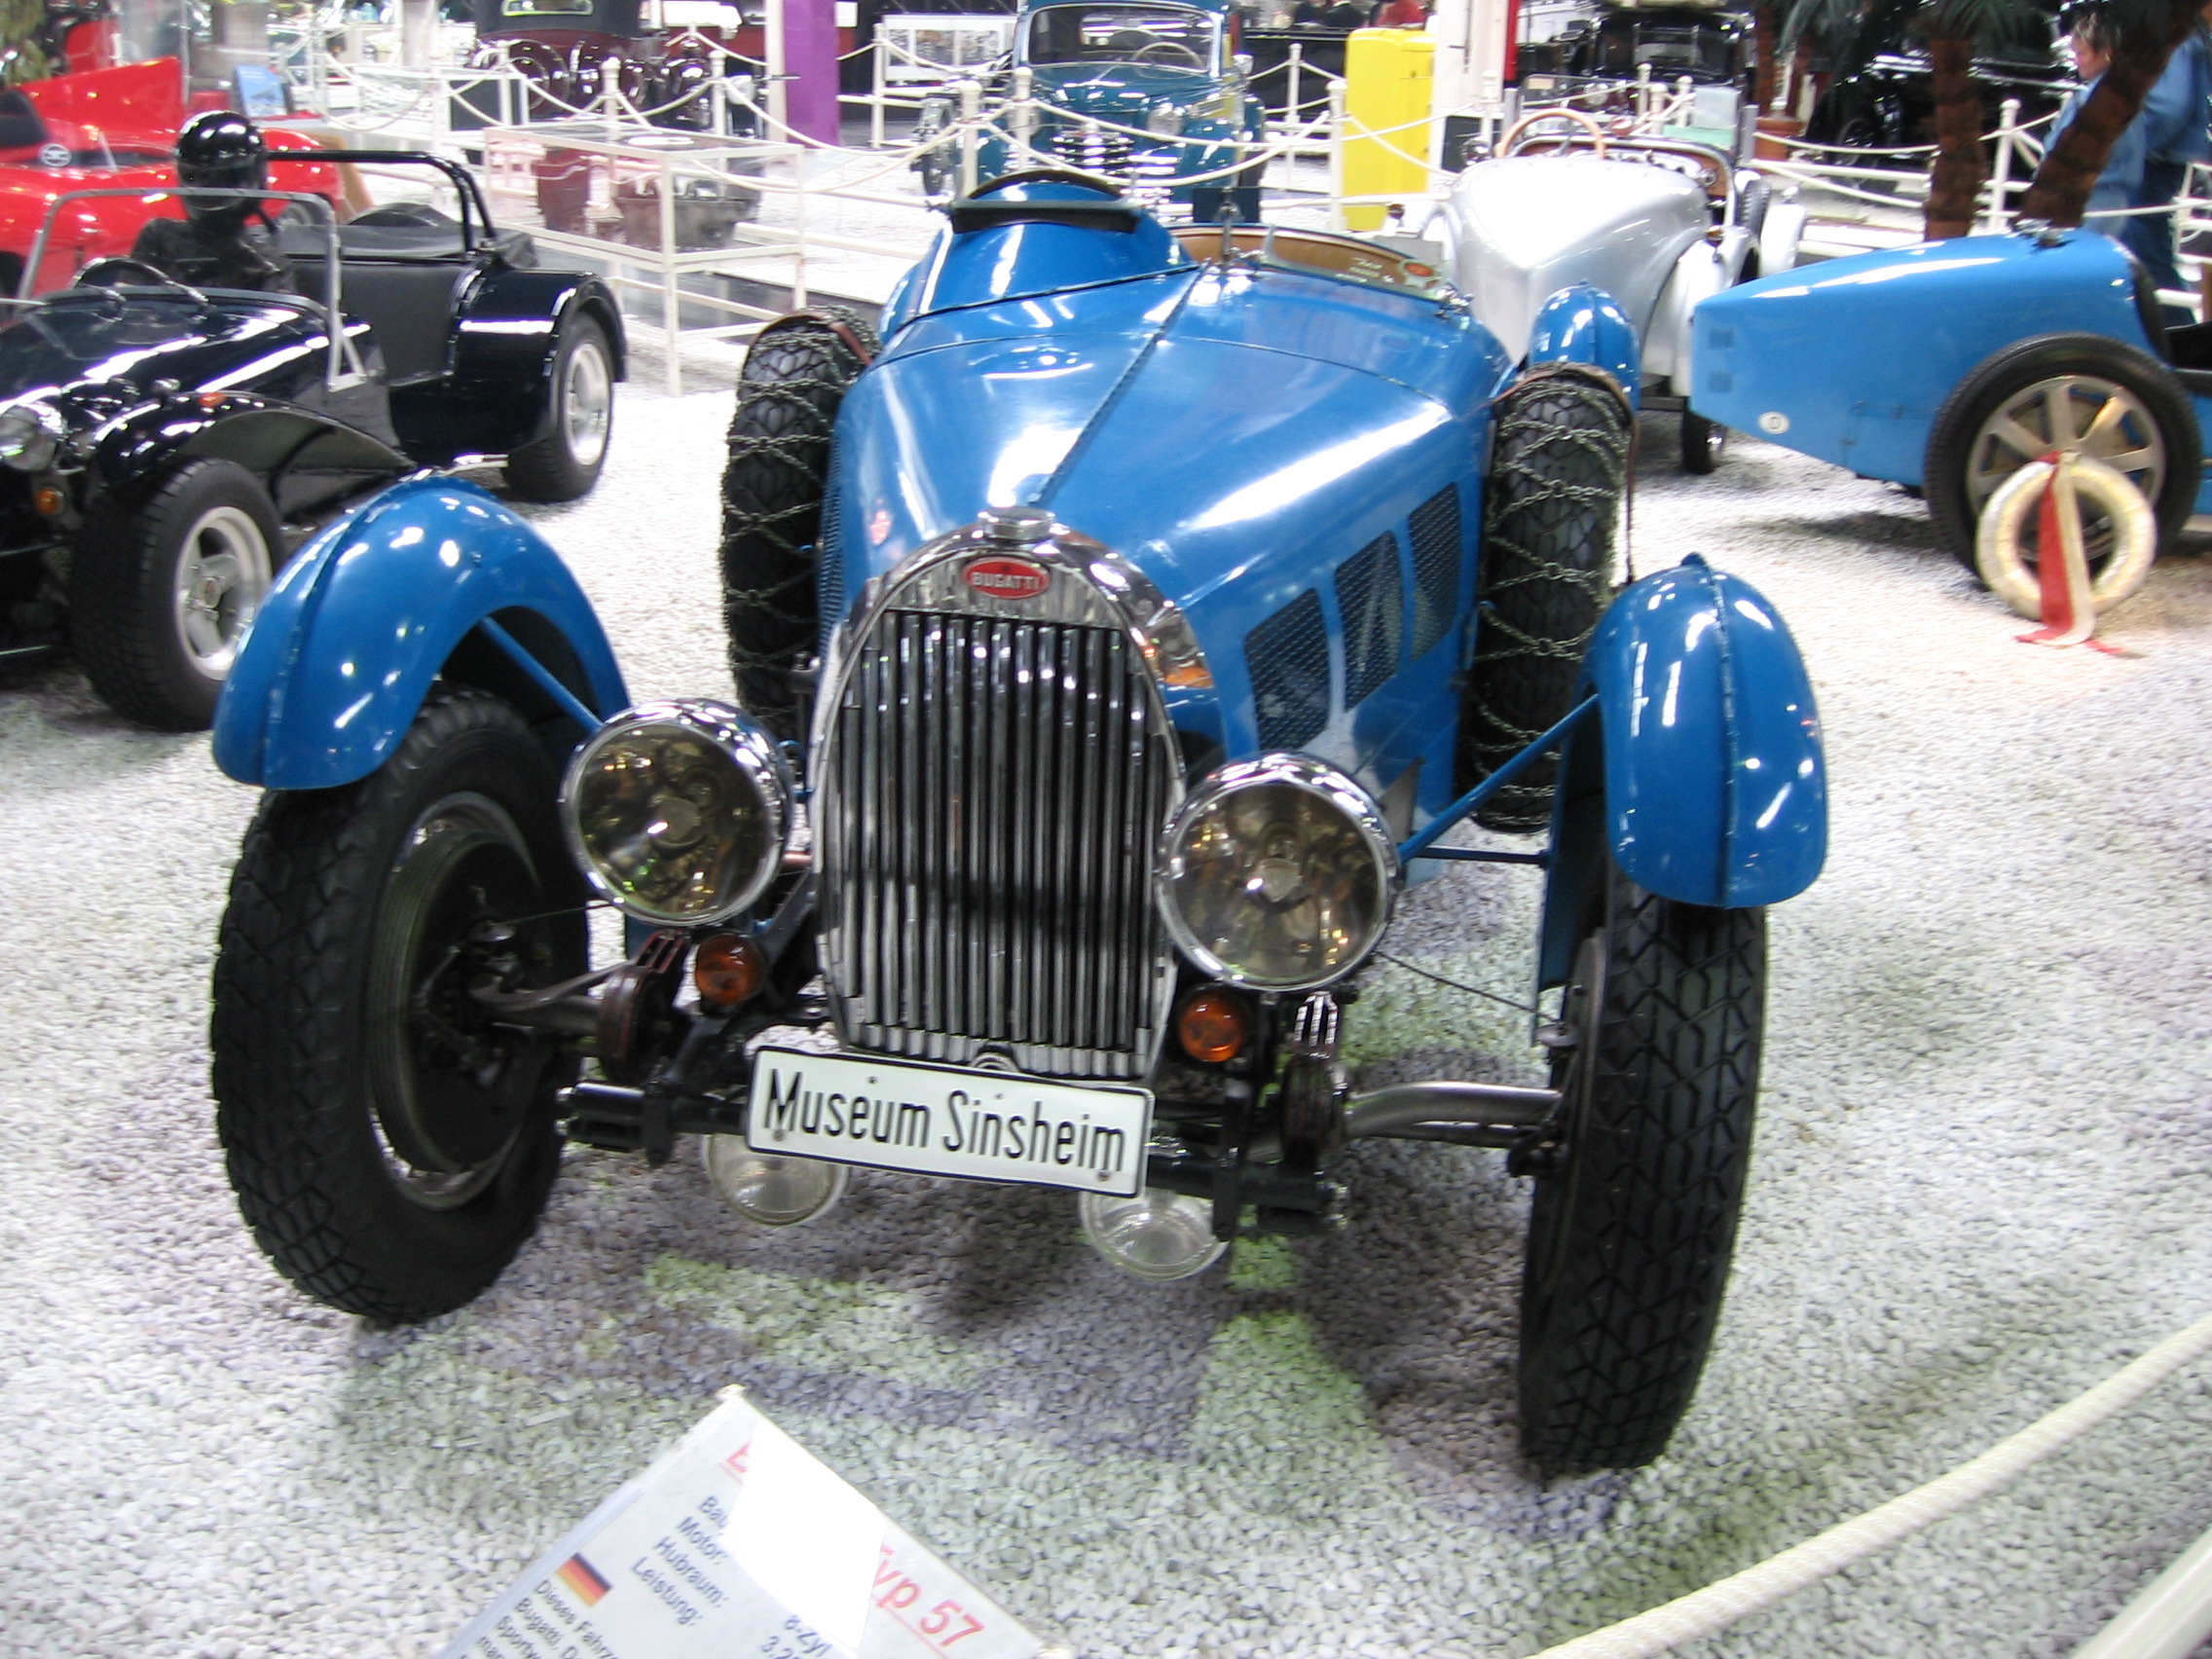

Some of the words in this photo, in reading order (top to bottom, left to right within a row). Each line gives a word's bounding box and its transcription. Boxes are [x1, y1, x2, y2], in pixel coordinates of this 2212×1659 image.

[763, 1068, 931, 1148] Museum
[941, 1089, 1126, 1172] Sinsheim
[535, 1579, 577, 1625] Dieses
[631, 1556, 703, 1627] Leistung:
[653, 1535, 730, 1608] Hubraum:
[920, 1599, 985, 1647] 57
